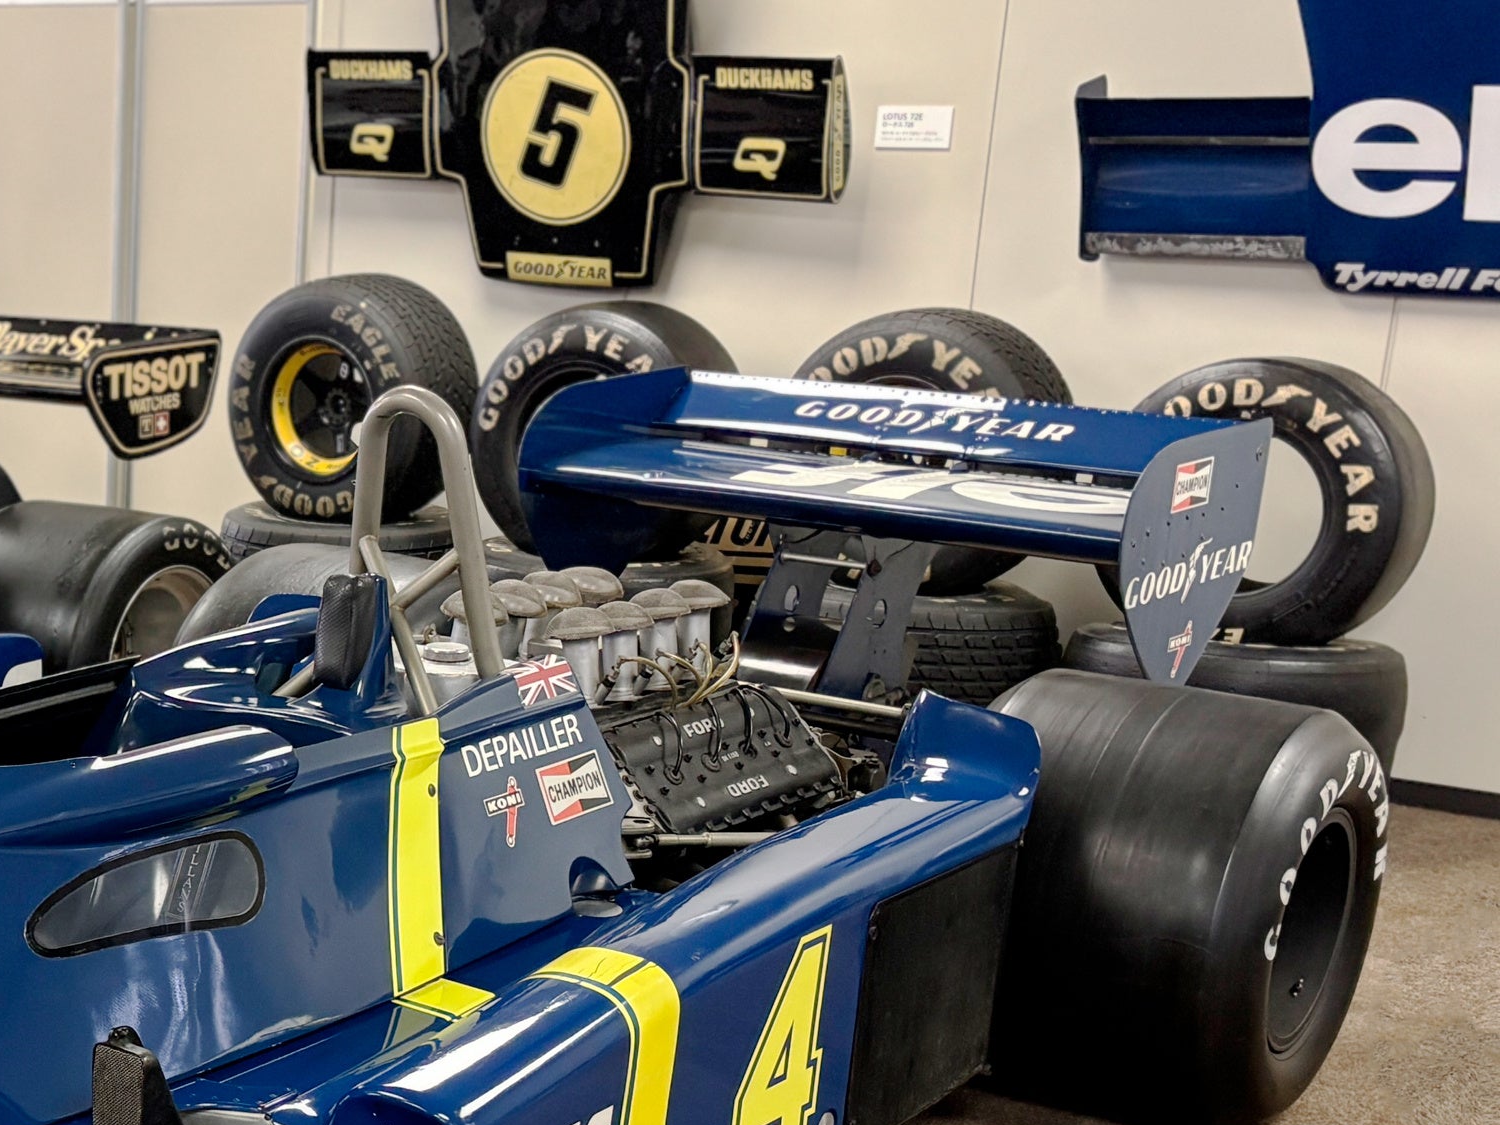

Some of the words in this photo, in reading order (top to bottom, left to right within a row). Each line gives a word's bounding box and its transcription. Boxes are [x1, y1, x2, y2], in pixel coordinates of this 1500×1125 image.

[329, 59, 414, 81] DUCKHAMS
[715, 66, 815, 92] DUCKHAMS
[350, 123, 395, 162] Q
[520, 76, 598, 190] 5
[733, 137, 787, 181] Q
[1334, 262, 1470, 292] Tyrrell
[332, 303, 400, 381] EAGLE
[103, 352, 207, 401] TISSOT
[128, 393, 182, 416] WATCHES
[1175, 473, 1209, 497] CHAMPION
[460, 713, 584, 778] DEPAILLER
[547, 771, 602, 804] CHAMPION
[727, 774, 771, 798] FORD
[487, 794, 524, 813] KONI
